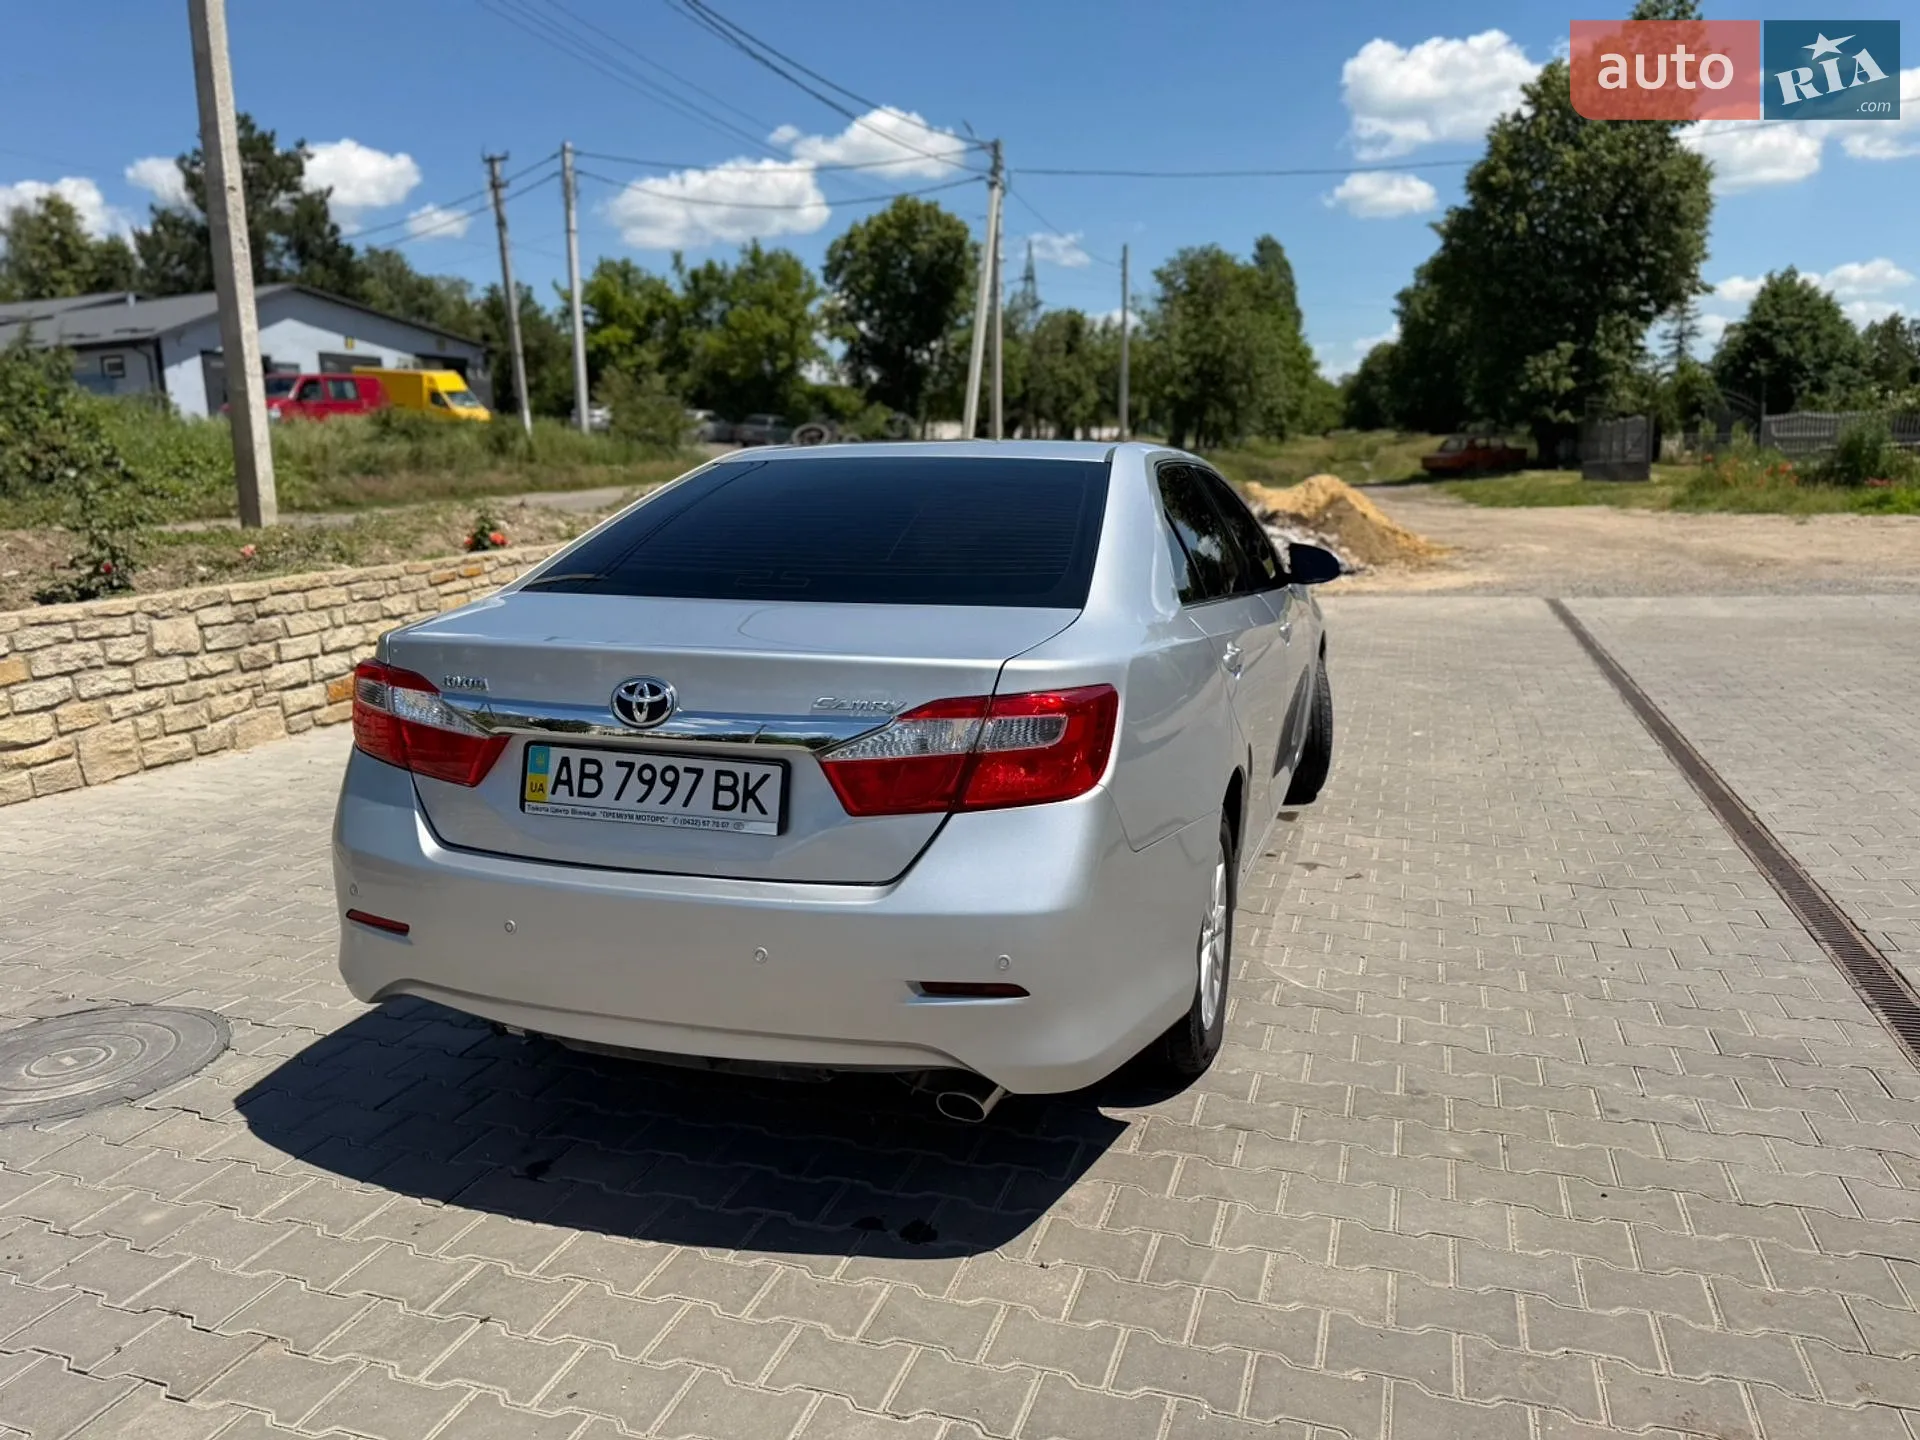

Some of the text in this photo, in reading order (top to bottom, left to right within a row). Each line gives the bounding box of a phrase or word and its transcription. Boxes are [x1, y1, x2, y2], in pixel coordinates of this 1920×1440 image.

[529, 782, 545, 795] UA
[550, 756, 771, 816] AB 7997 BK
